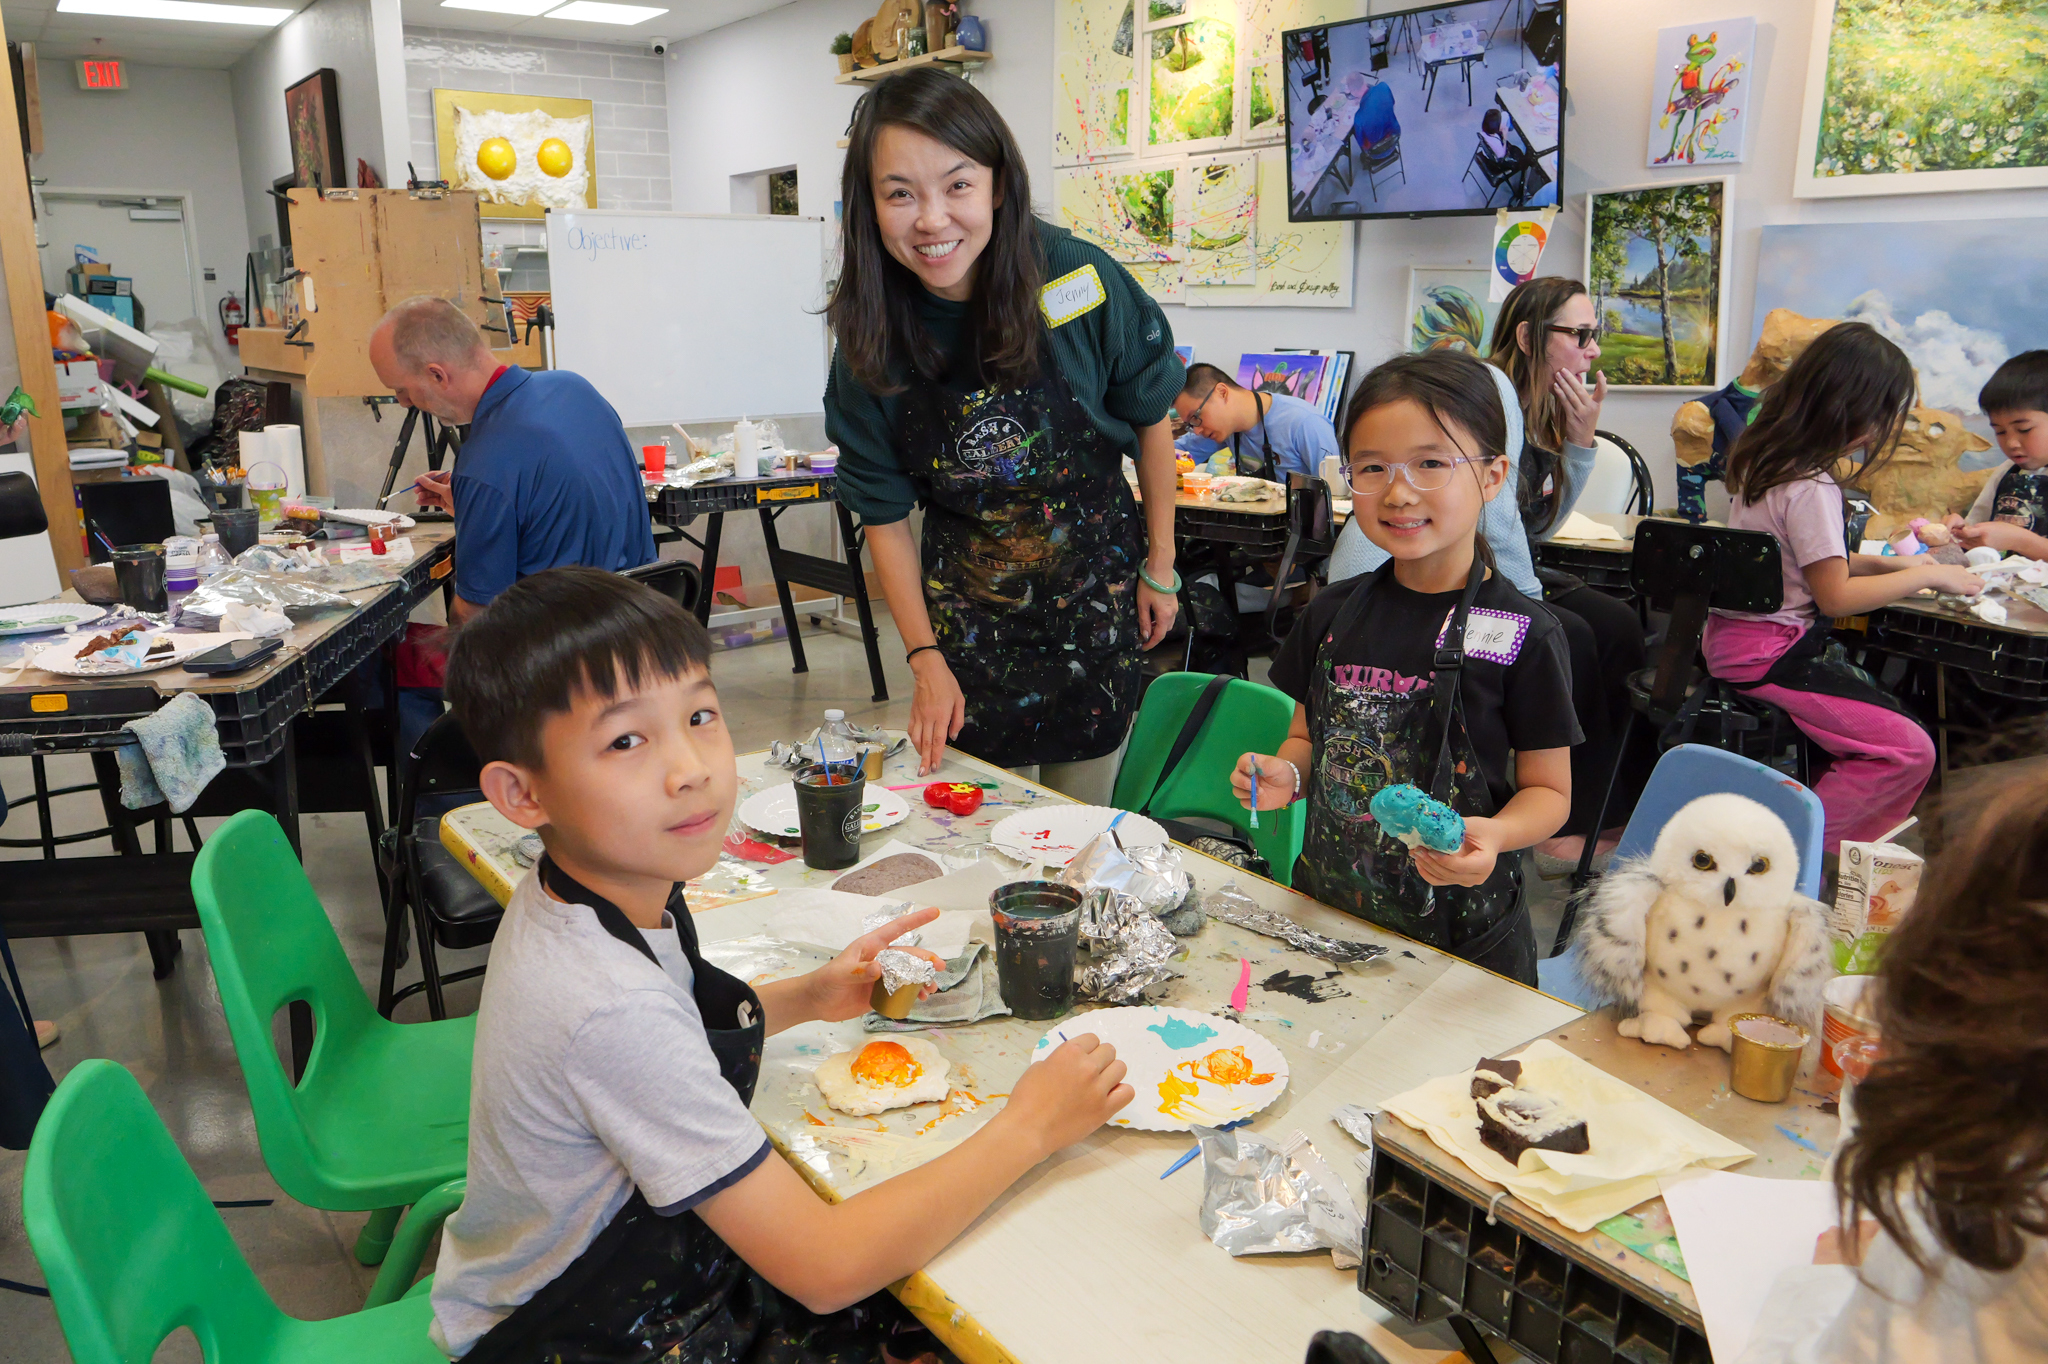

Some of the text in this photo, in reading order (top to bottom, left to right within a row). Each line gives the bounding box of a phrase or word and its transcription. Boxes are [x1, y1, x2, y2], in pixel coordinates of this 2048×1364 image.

[83, 61, 121, 87] EXIT
[567, 226, 647, 262] Objective:
[1056, 282, 1090, 305] Jenny
[1465, 623, 1504, 645] ennie
